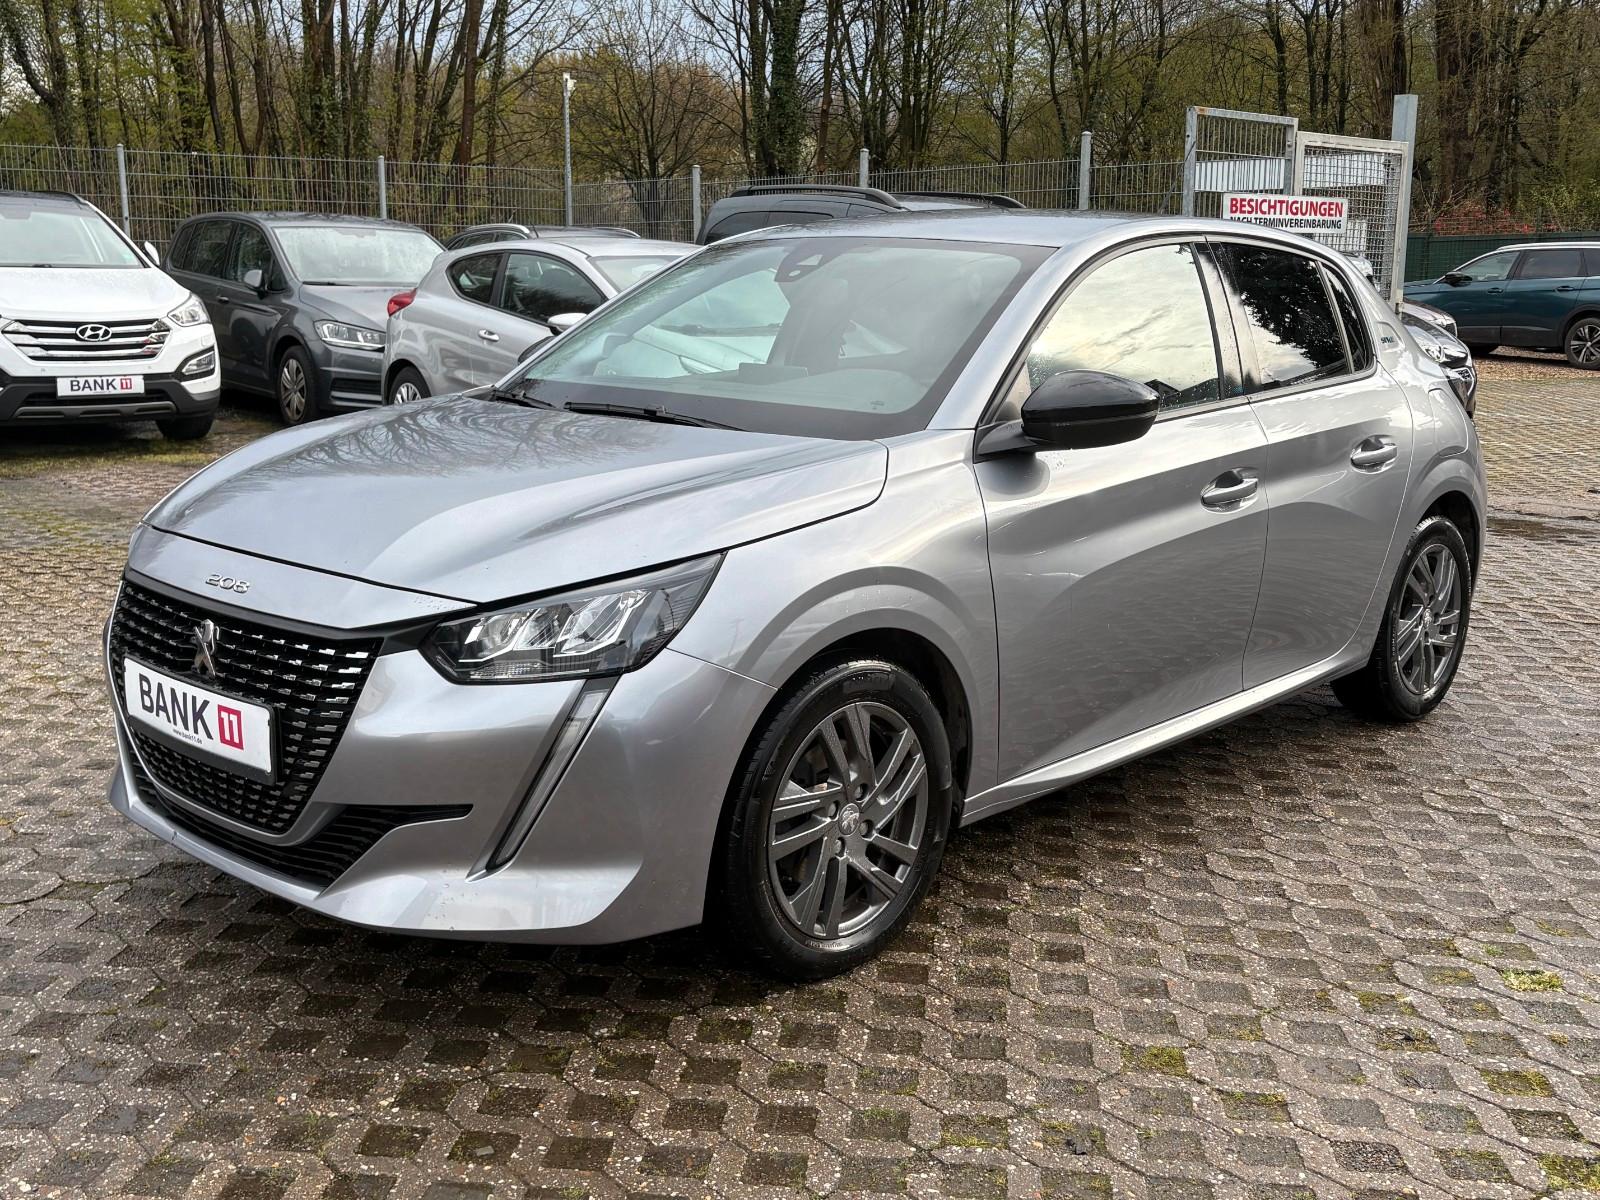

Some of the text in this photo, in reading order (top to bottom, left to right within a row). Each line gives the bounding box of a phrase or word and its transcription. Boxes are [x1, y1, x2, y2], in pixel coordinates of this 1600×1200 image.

[1229, 197, 1343, 217] BESICHTIGUNGEN
[1253, 217, 1342, 229] TERMINVEREINBARUNG
[70, 378, 132, 392] BANK 11
[205, 573, 249, 594] 208
[138, 673, 241, 746] BANK 11
